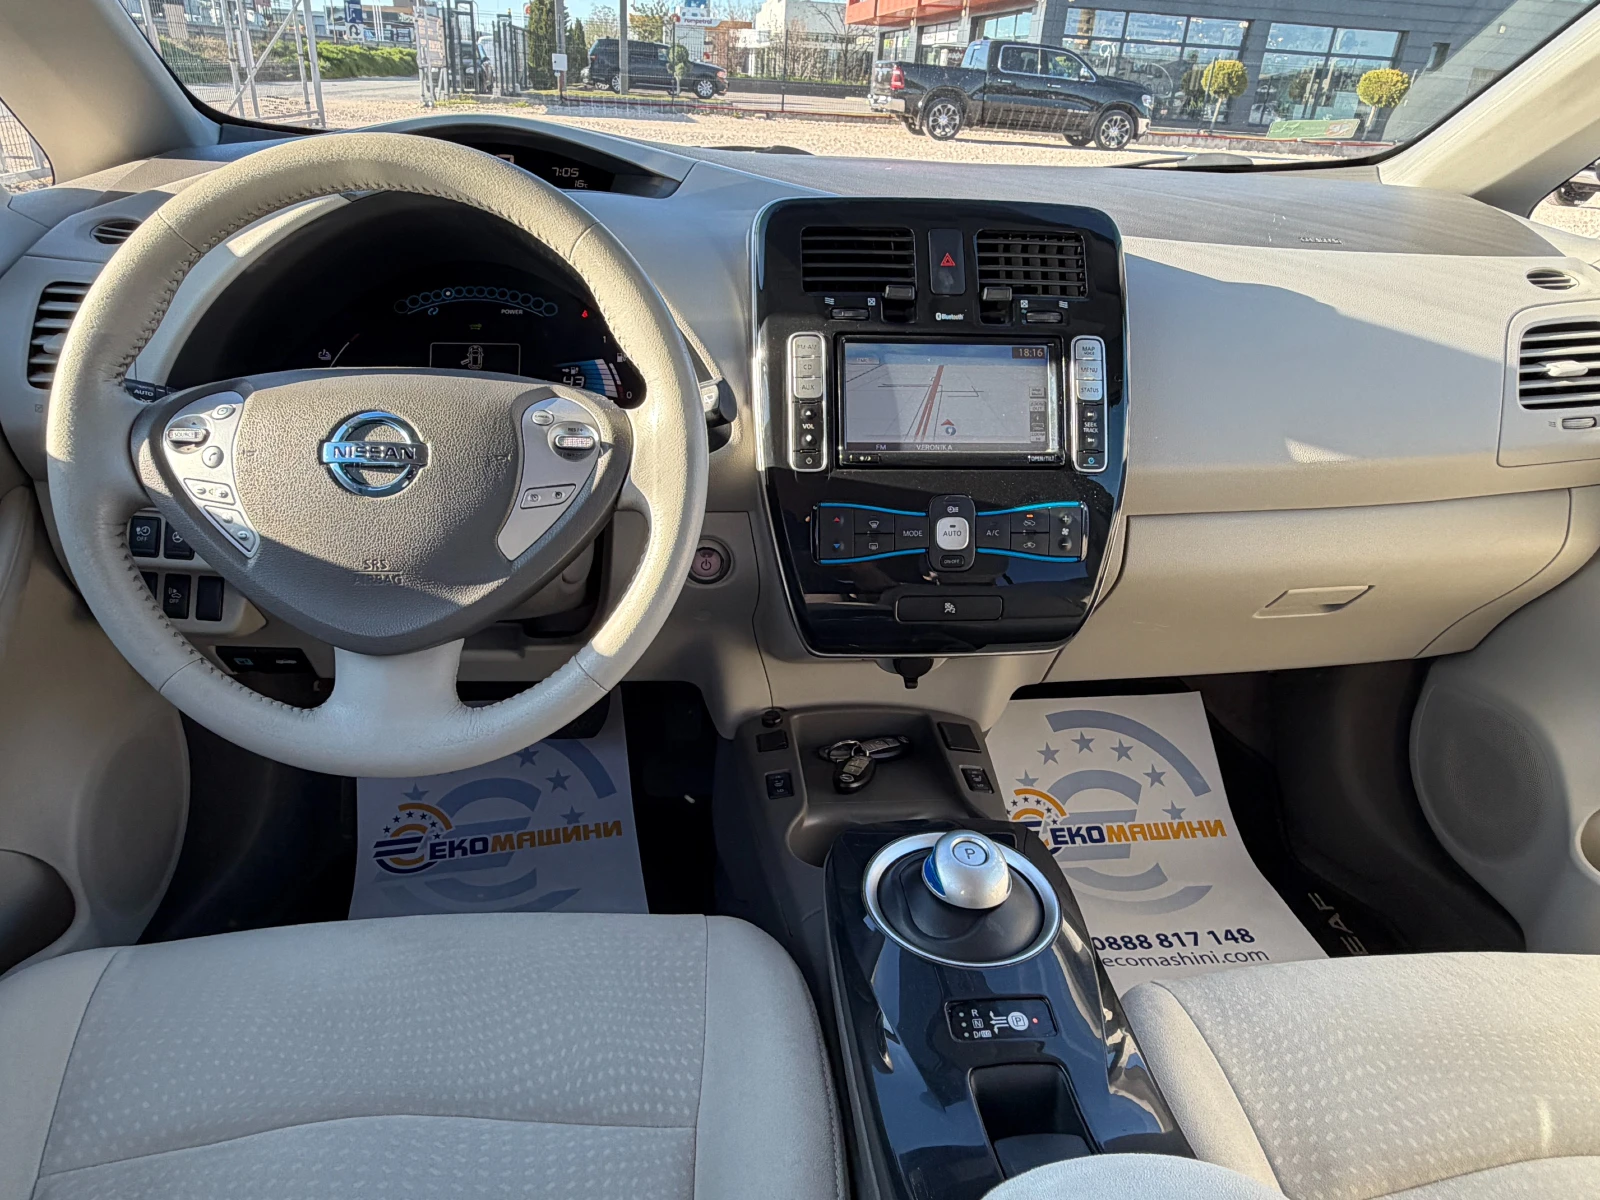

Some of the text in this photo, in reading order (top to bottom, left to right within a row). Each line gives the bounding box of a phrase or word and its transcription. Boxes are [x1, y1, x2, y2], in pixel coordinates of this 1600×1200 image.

[551, 167, 579, 177] 7:05
[1019, 348, 1043, 357] 18:16
[133, 389, 154, 397] AUTO
[333, 446, 416, 460] NISSAN
[364, 559, 389, 570] SRS
[1049, 819, 1228, 846] ЕКОМАШИНИ
[428, 820, 623, 861] ЕКОМАШИНИ
[964, 848, 976, 860] P
[1090, 928, 1256, 951] 0888 817 148
[1102, 949, 1270, 967] ecomashini.com
[971, 1008, 979, 1017] R
